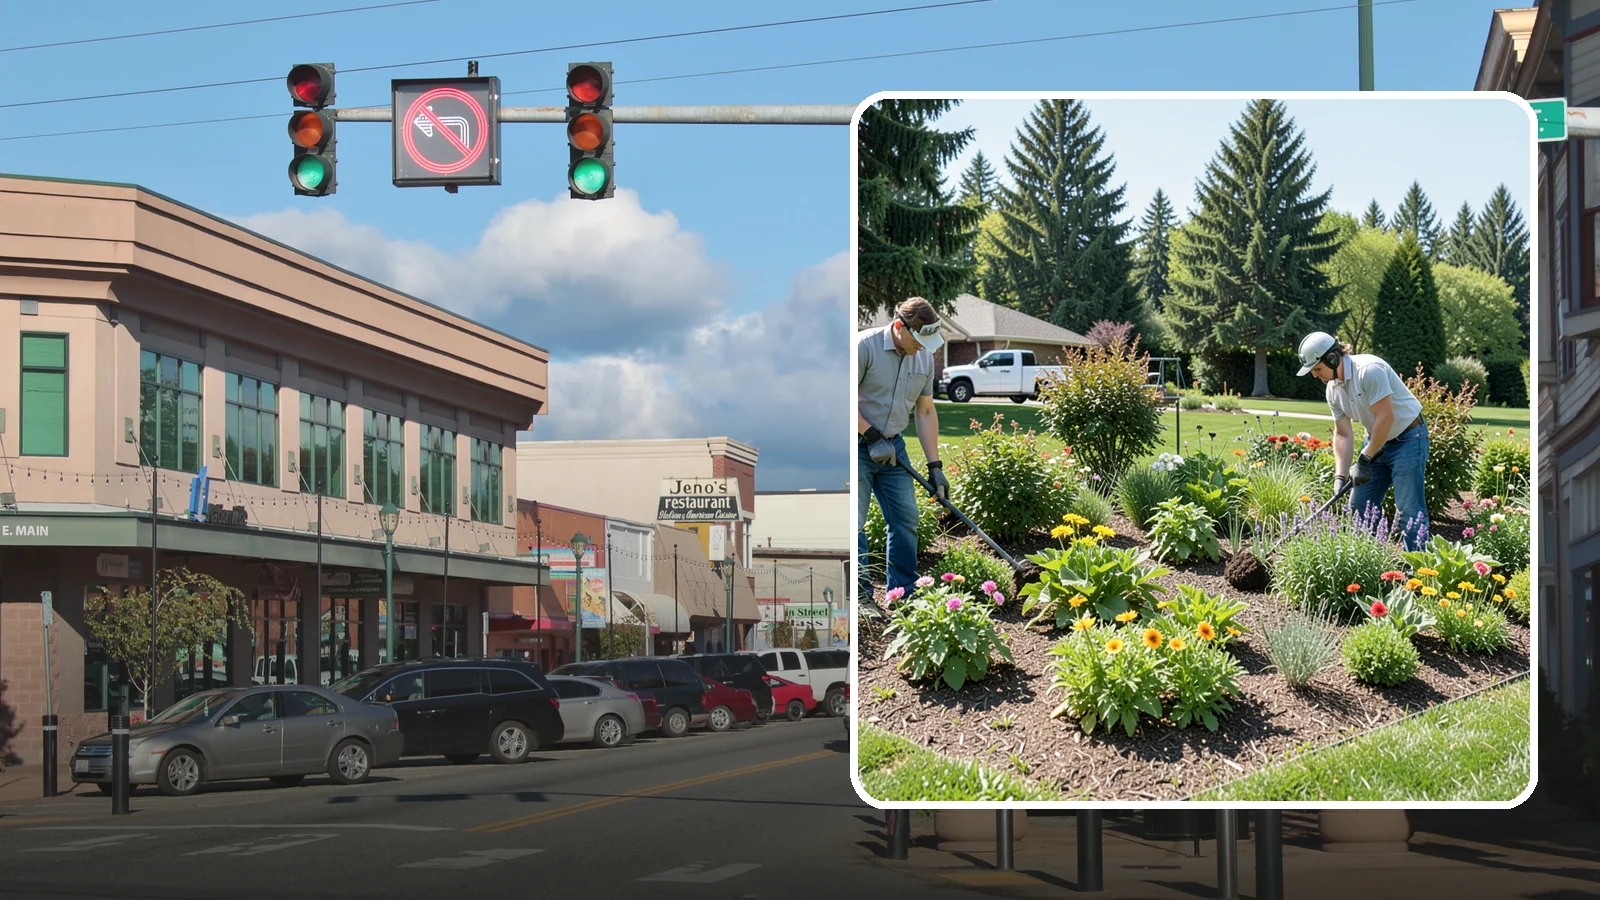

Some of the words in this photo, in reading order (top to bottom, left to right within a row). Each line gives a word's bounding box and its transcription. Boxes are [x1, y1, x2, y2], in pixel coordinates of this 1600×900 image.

[669, 480, 727, 494] Jeno's
[665, 496, 731, 509] restaurant
[658, 509, 682, 519] Italian
[685, 509, 714, 519] American
[715, 509, 738, 519] Cuisine
[2, 525, 13, 537] E.
[15, 525, 49, 537] MAIN
[797, 606, 828, 617] Street
[790, 619, 824, 627] lass
